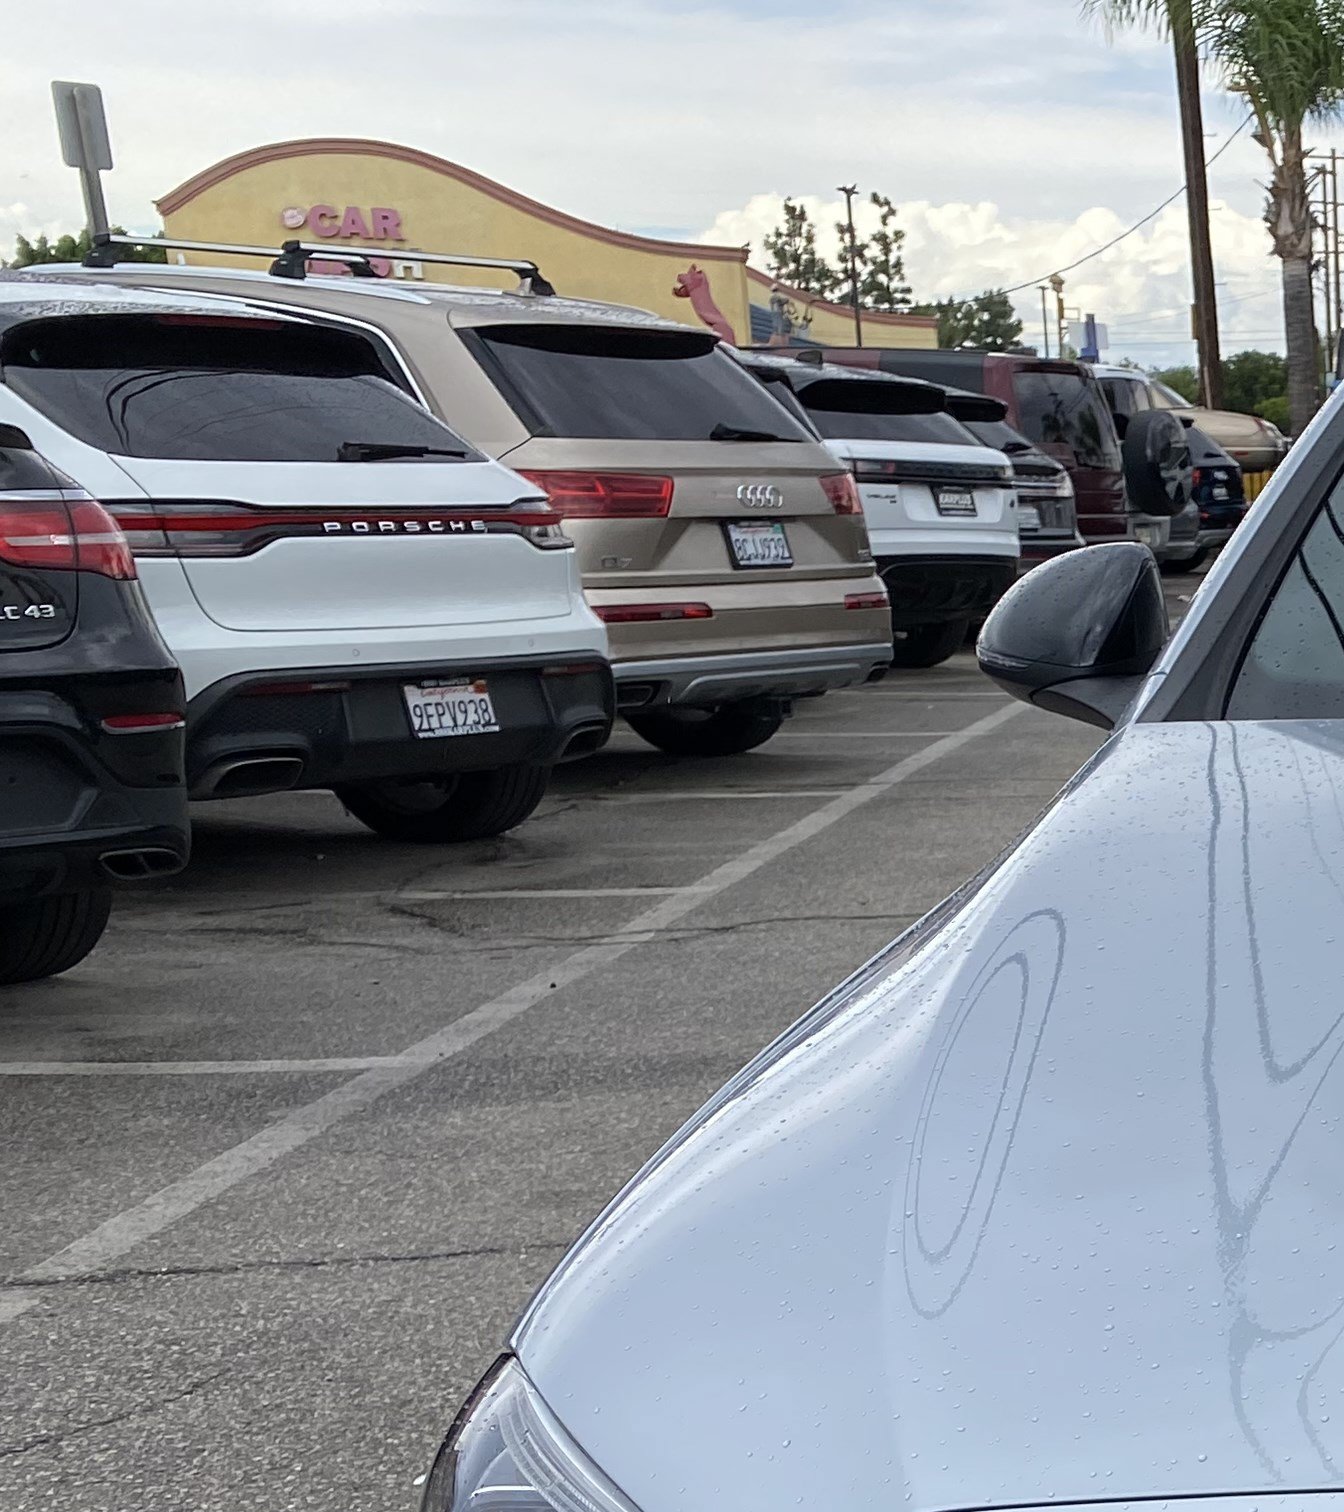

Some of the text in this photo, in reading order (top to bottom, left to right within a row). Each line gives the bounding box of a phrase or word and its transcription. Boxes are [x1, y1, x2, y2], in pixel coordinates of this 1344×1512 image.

[307, 203, 407, 242] CAR
[322, 520, 487, 533] PORSCHE
[24, 604, 56, 619] 43
